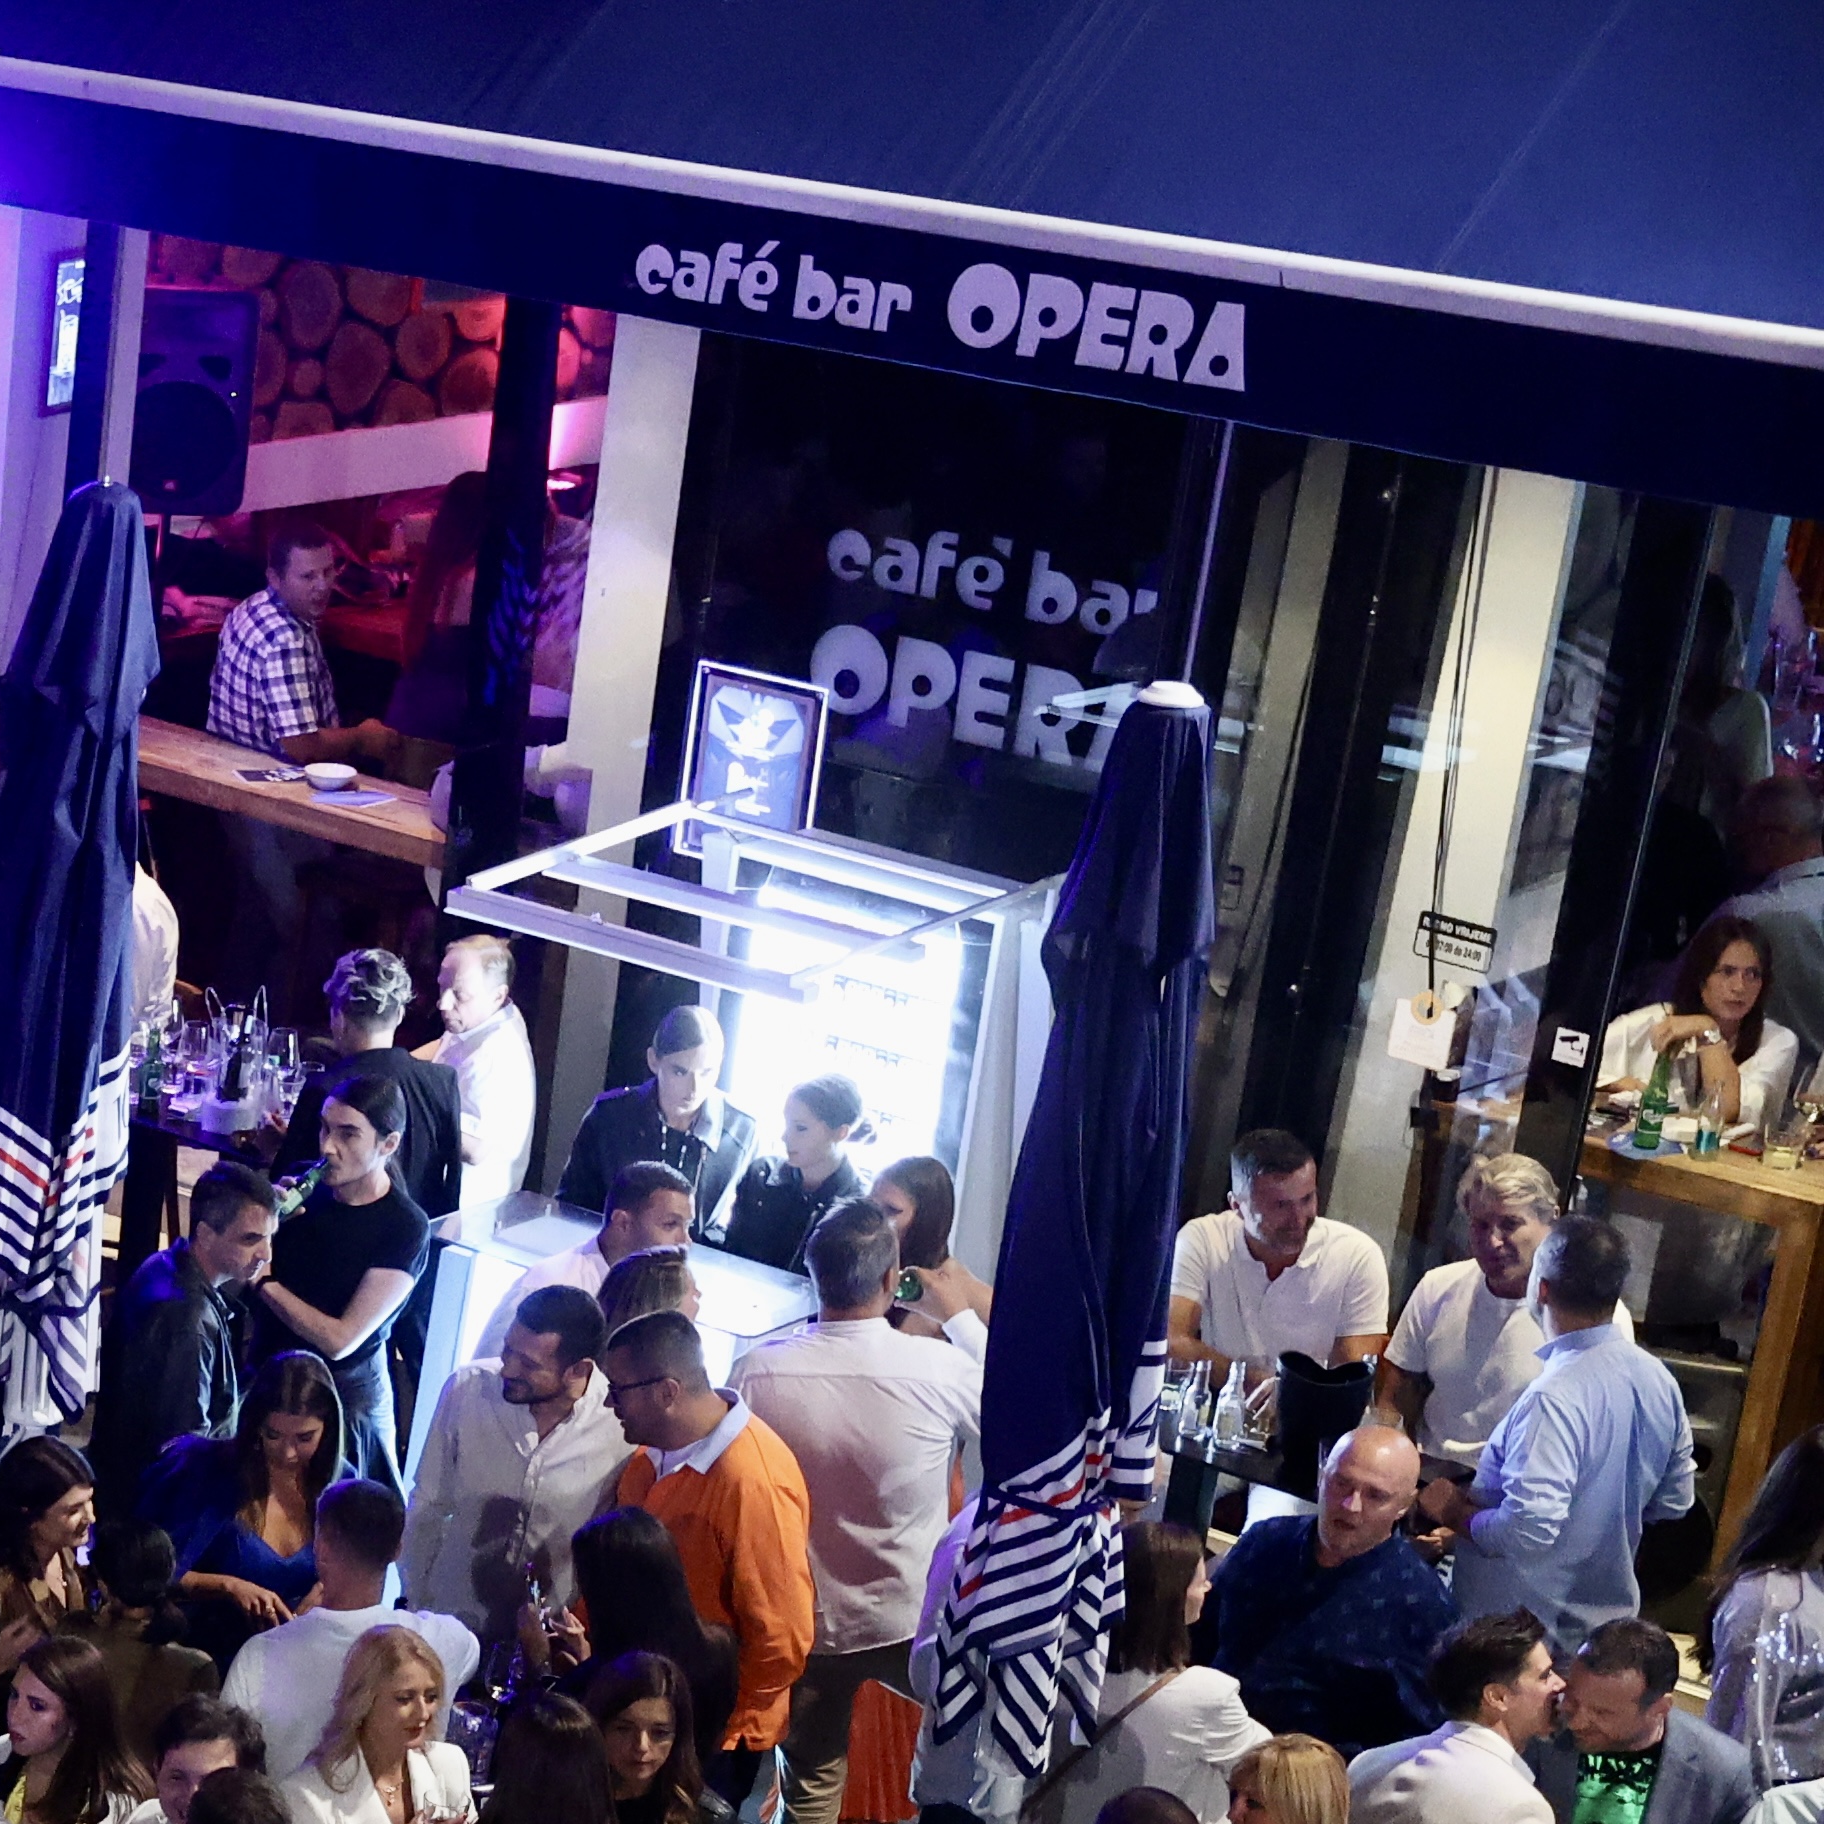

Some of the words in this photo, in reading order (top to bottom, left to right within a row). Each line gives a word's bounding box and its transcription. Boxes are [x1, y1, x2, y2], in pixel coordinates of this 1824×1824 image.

[635, 239, 780, 313] café
[792, 254, 913, 333] bar
[947, 262, 1247, 393] OPERA
[827, 527, 1013, 608] café
